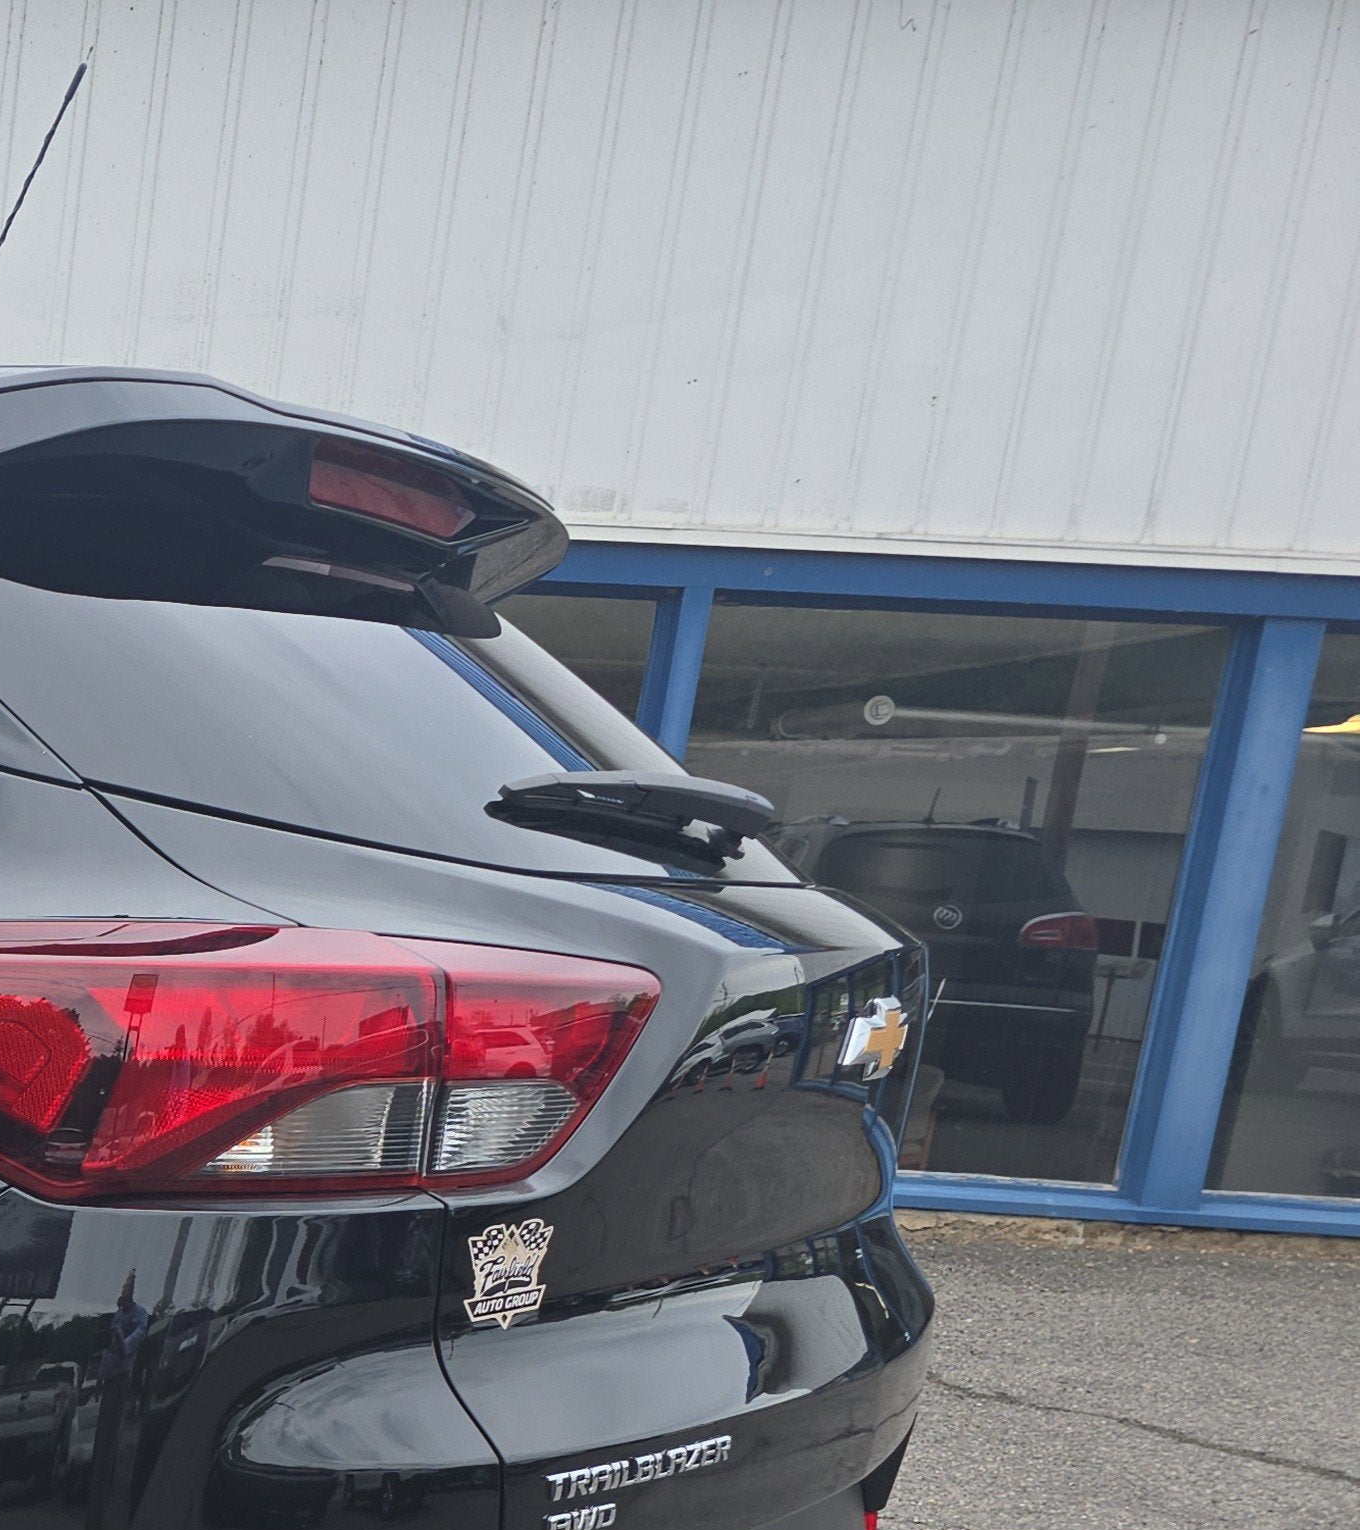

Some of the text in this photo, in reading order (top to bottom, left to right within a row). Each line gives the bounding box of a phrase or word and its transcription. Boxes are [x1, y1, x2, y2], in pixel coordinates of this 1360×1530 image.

[473, 1291, 539, 1315] AUTO GROUP
[544, 1434, 732, 1502] TRAILBLAZER
